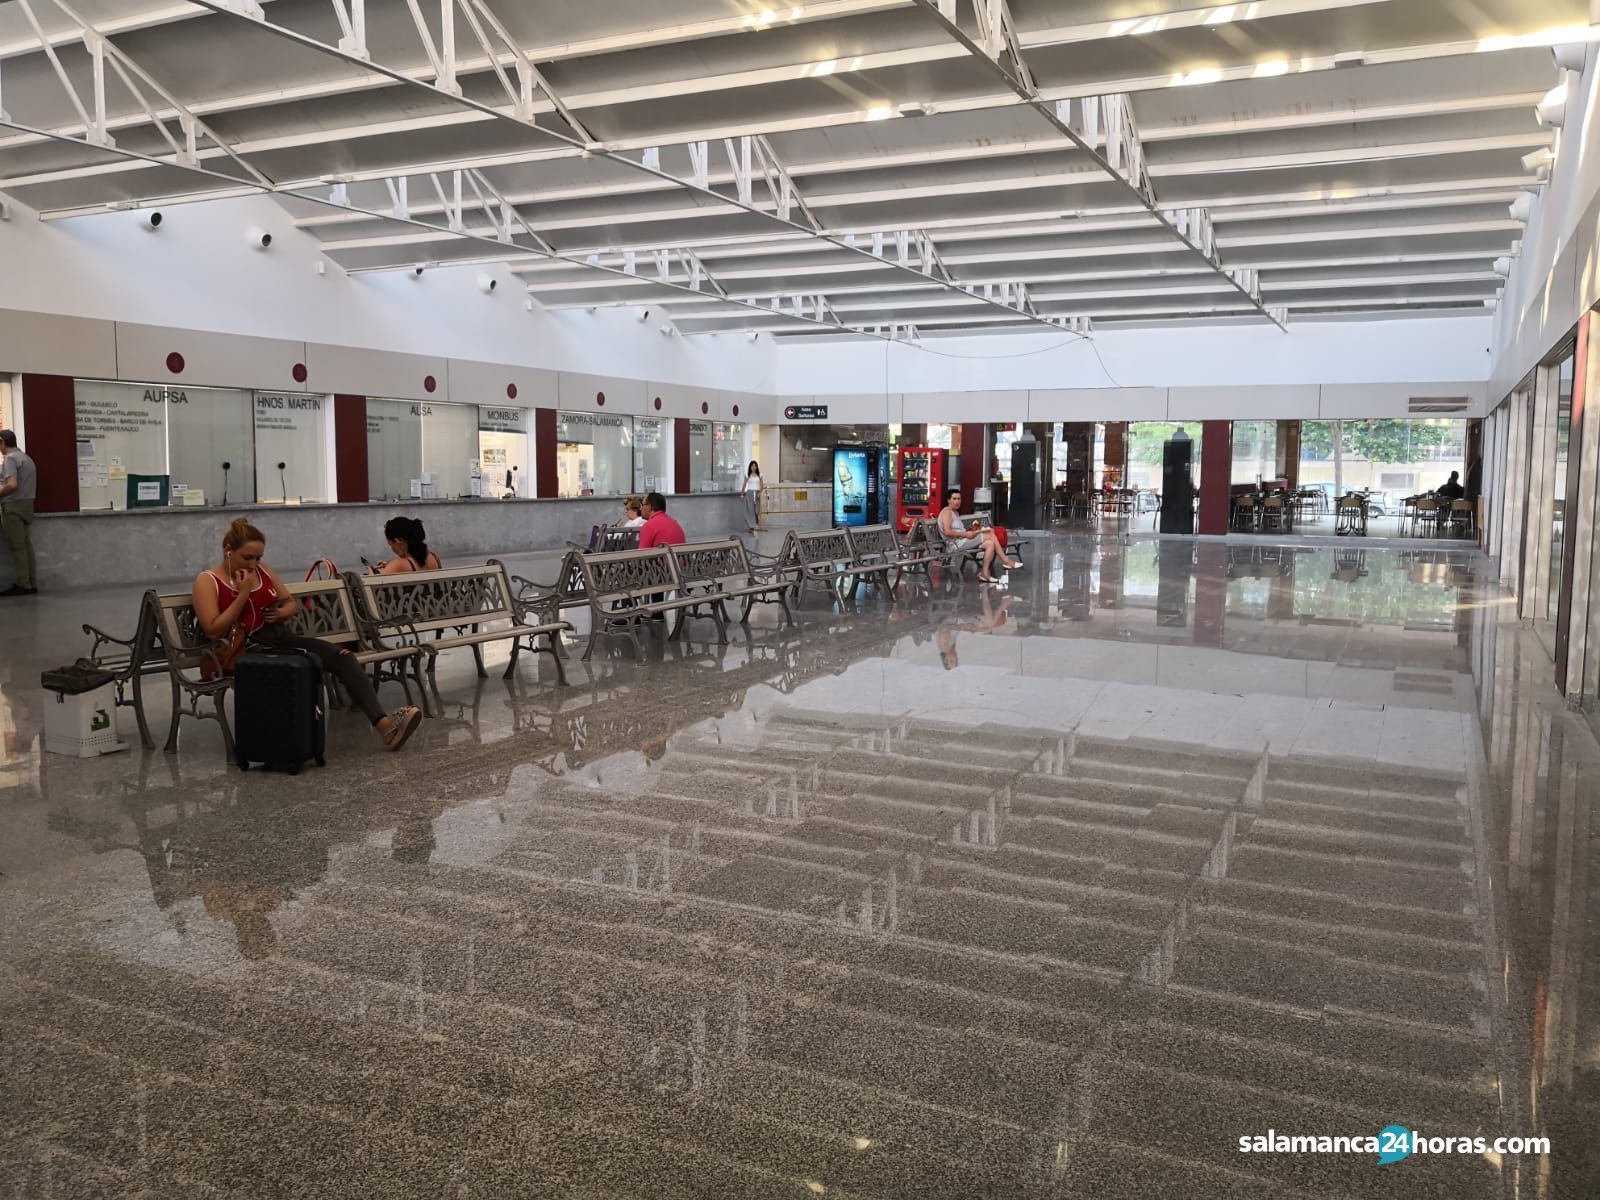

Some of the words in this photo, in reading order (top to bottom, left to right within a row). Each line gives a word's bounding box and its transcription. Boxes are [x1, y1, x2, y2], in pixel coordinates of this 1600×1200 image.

[143, 389, 188, 404] AUPSA
[410, 405, 432, 416] ALSA
[487, 410, 519, 422] MONBUS
